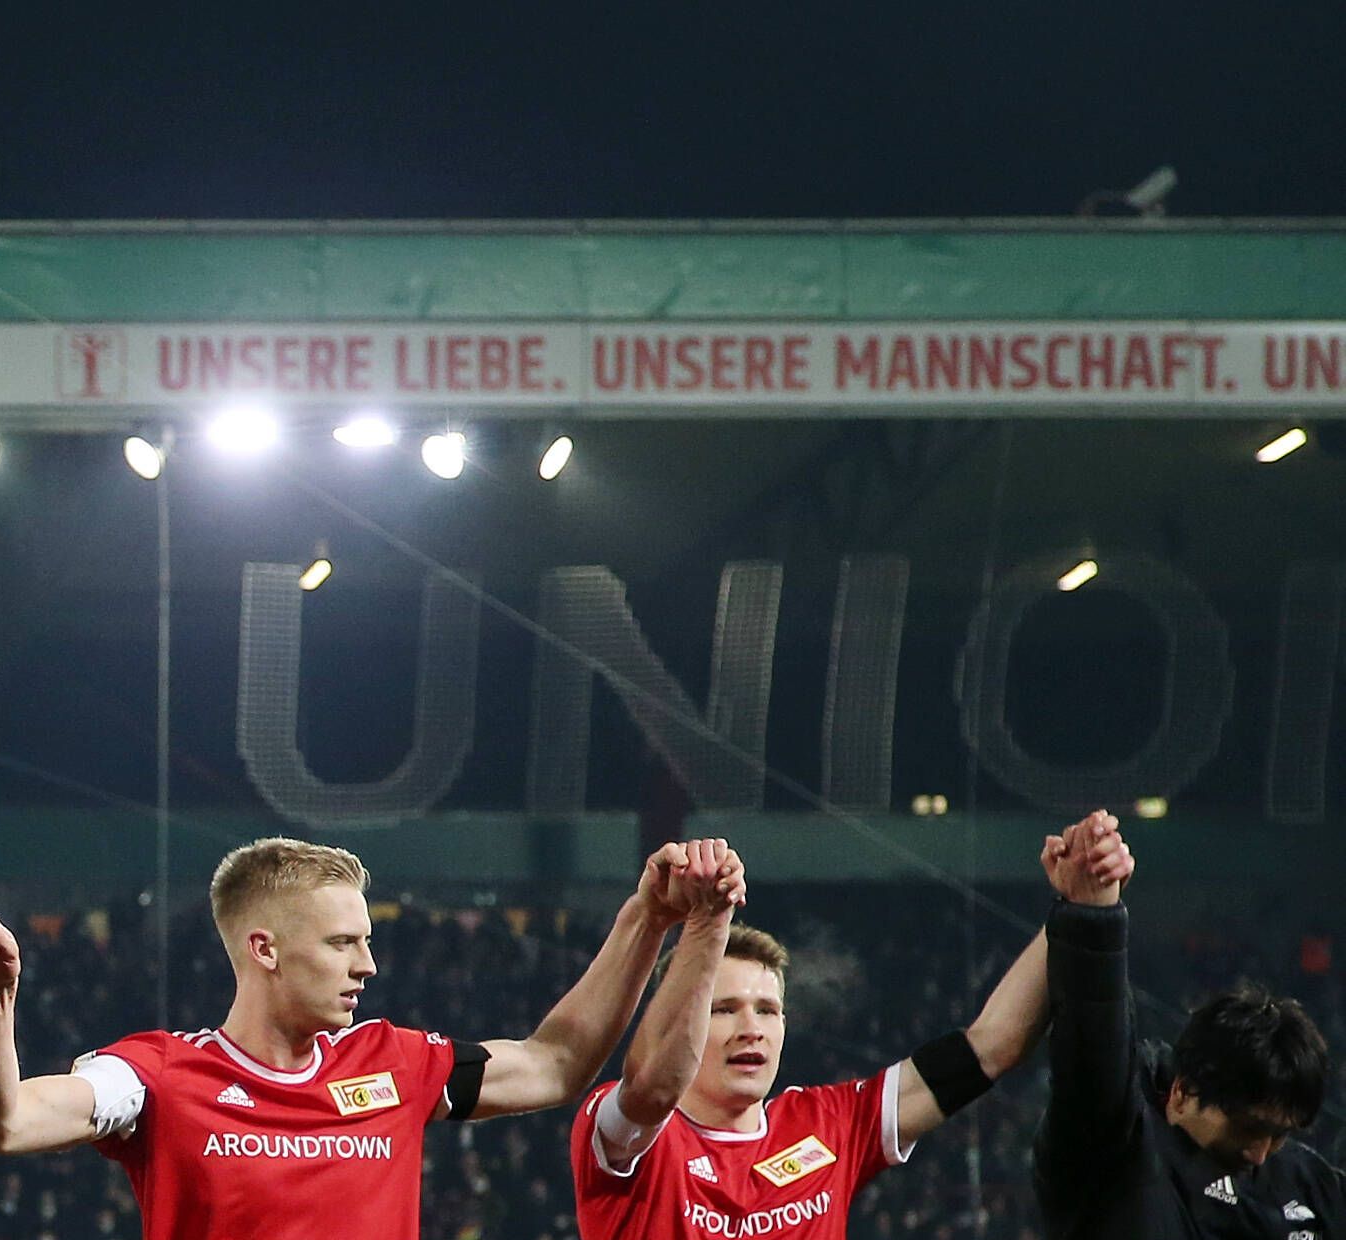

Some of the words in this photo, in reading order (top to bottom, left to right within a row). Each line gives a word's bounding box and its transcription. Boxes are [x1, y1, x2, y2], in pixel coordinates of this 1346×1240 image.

[158, 335, 373, 393] UNSERE
[396, 335, 566, 393] LIEBE.
[593, 335, 811, 393] UNSERE
[833, 335, 1238, 393] MANNSCHAFT.
[1264, 334, 1342, 392] UN
[203, 1133, 392, 1160] AROUNDTOWN
